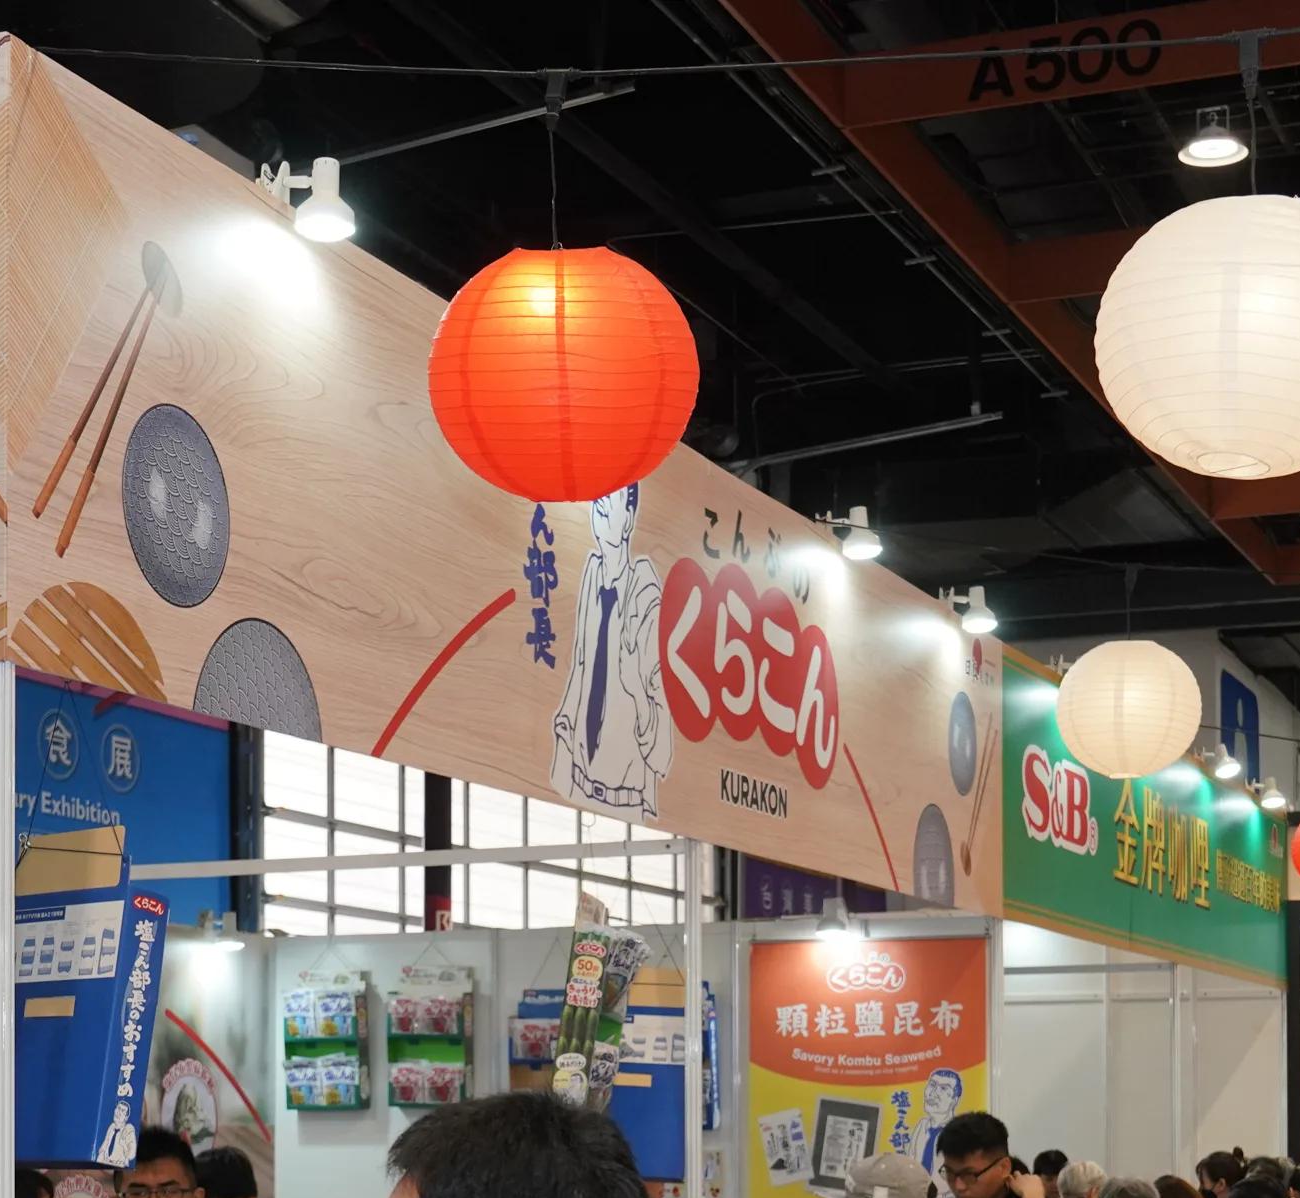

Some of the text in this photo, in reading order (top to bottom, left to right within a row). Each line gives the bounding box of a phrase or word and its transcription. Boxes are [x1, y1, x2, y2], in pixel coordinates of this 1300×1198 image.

[666, 583, 837, 770] くらこん
[41, 792, 121, 824] Exhibition
[720, 769, 789, 819] KURAKON
[1024, 752, 1091, 848] S&B
[1113, 778, 1211, 909] 金牌咖哩
[133, 896, 165, 916] くらこん
[830, 967, 903, 989] くらこん
[116, 919, 156, 1098] 塩こん部長のおすすめ
[775, 1000, 964, 1039] 顆粒鹽昆布
[791, 1045, 942, 1066] Savory Kombu Seaweed
[889, 1090, 912, 1155] 塩こん部
